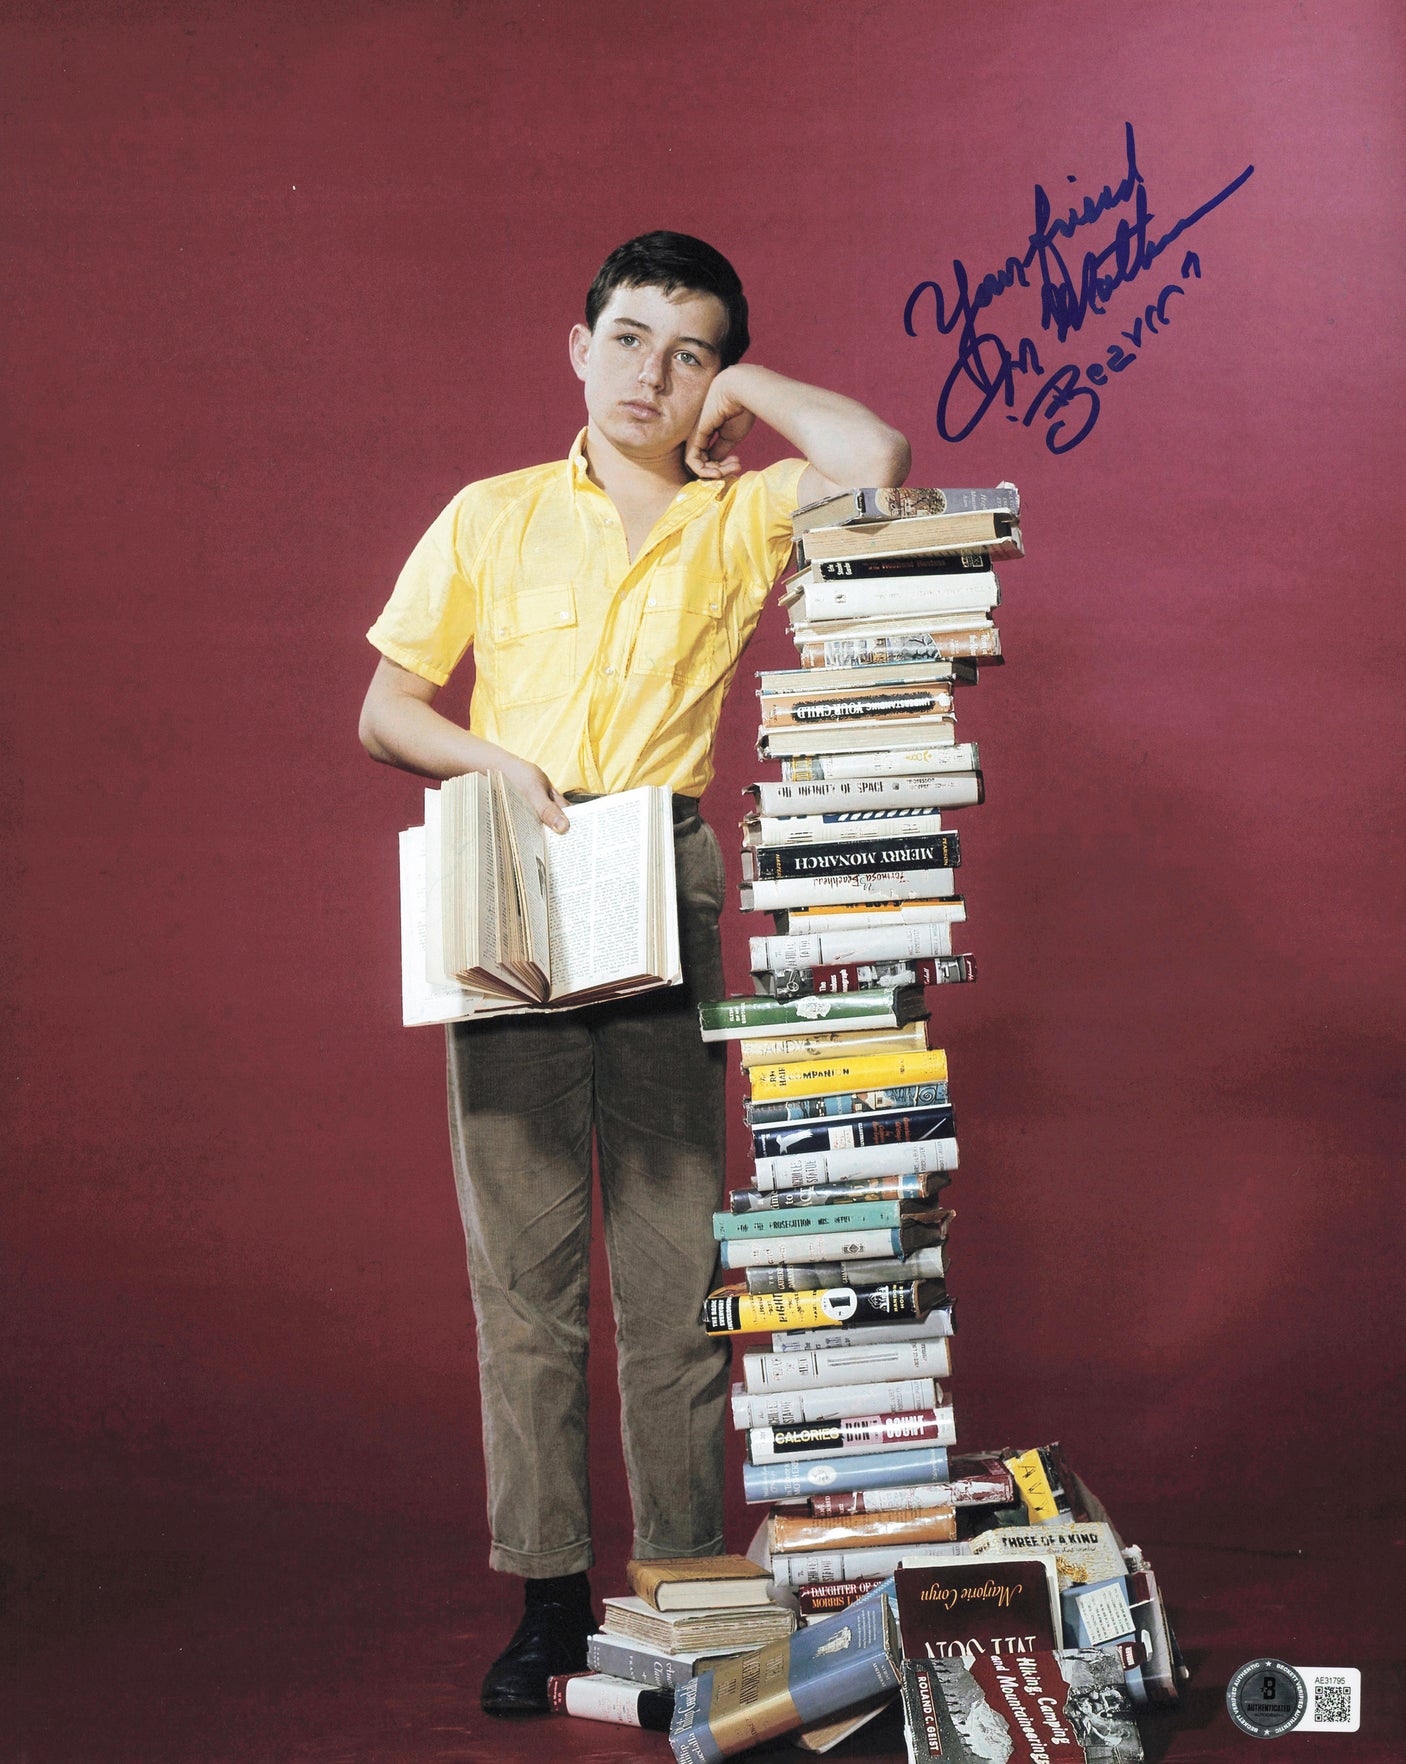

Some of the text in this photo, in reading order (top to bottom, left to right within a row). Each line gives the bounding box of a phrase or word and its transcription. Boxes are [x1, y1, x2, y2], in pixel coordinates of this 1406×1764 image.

[796, 697, 932, 719] UNDERSTANDING YOUR CHILD
[857, 781, 884, 794] SPACE
[794, 847, 934, 870] MERRY MONARCH
[818, 980, 827, 992] The
[785, 1193, 794, 1205] to
[718, 1299, 726, 1327] EVERYDAY
[829, 1295, 851, 1310] 1
[775, 1426, 840, 1446] CALORIES
[885, 1415, 925, 1439] COUNT
[1002, 1535, 1038, 1548] THREE
[1041, 1534, 1056, 1547] OF
[1058, 1534, 1067, 1544] A
[1069, 1533, 1099, 1545] KIND
[810, 1583, 857, 1598] DAUGHTER
[859, 1582, 872, 1593] OF
[920, 1579, 1023, 1611] Marjorie Coryn
[811, 1597, 845, 1609] MORRIS
[1314, 1676, 1346, 1685] AE31795
[1015, 1656, 1070, 1745] Hiking, Camping
[1231, 1662, 1260, 1733] BECKETT VERIFIED AUTHENTIC
[1247, 1703, 1291, 1712] AUTHENTICATED
[1275, 1663, 1305, 1734] BECKETT VERIFIED AUTHENTIC
[917, 1675, 940, 1752] ROLAND C. GEIST
[989, 1654, 1051, 1764] and Mountaineering
